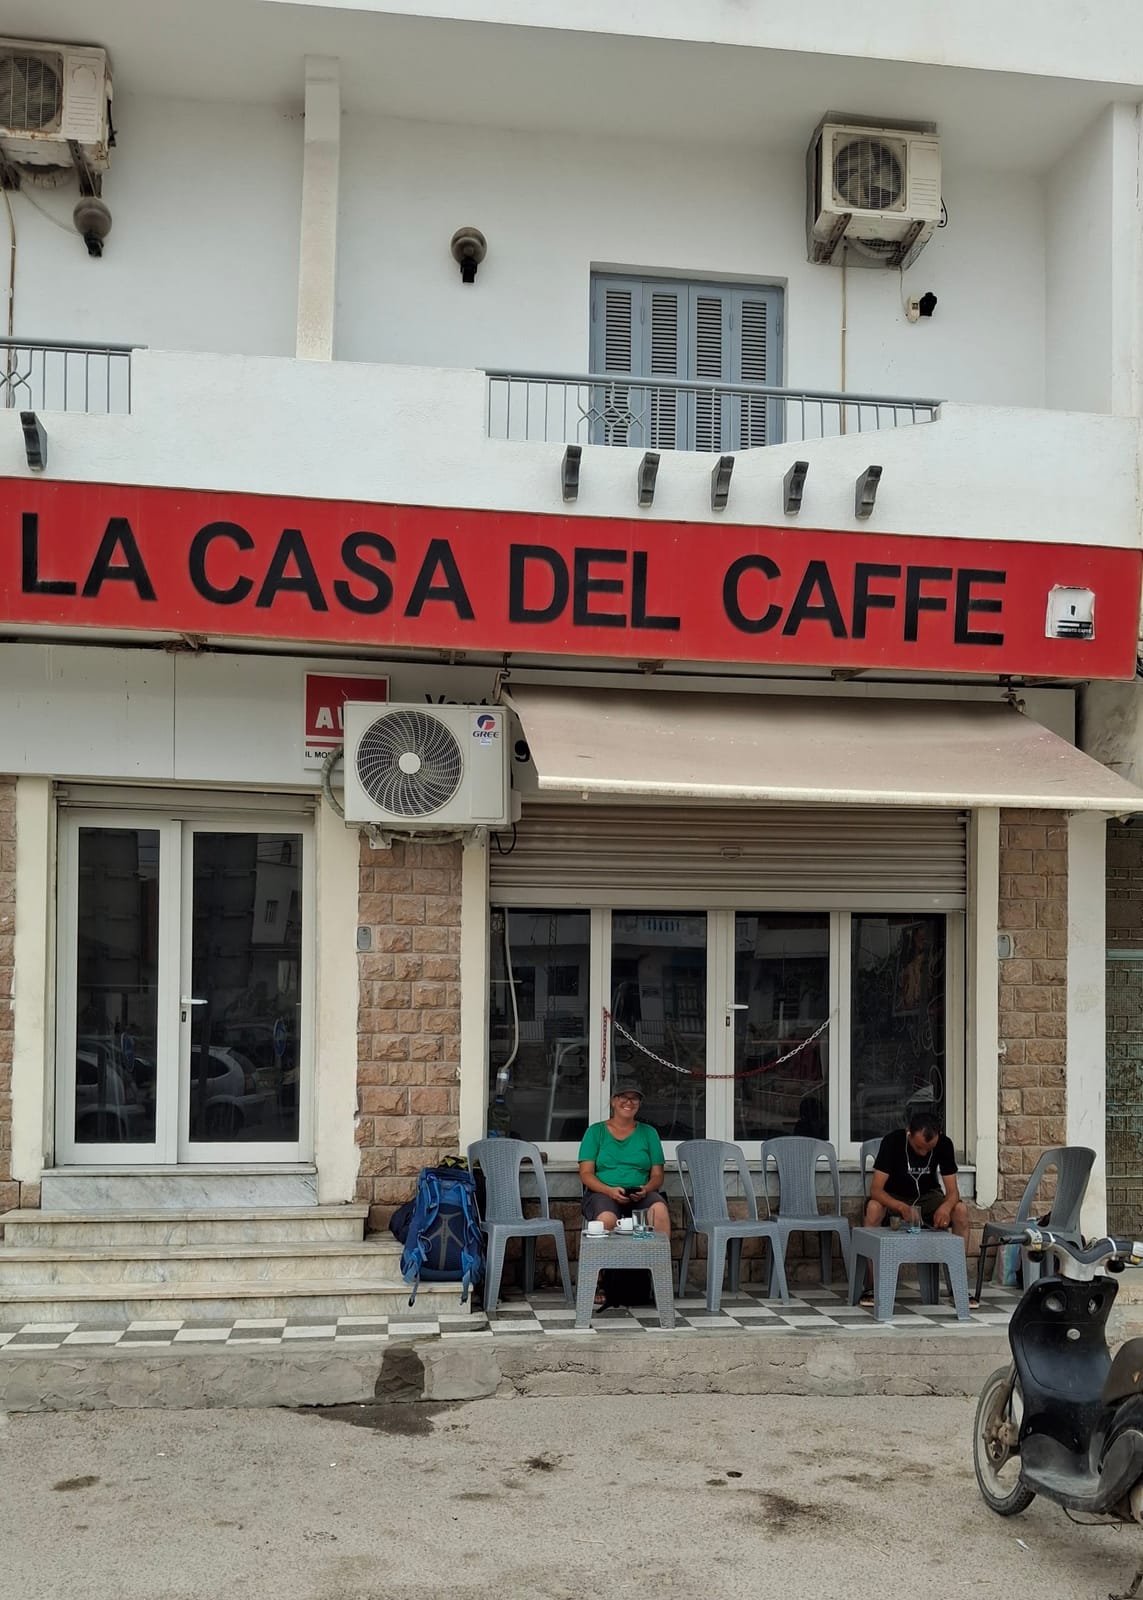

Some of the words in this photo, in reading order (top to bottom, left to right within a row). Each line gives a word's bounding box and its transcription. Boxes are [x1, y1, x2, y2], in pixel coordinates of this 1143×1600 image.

[21, 512, 157, 602] LA
[188, 521, 476, 621] CASA
[508, 544, 681, 632] DEL
[722, 554, 1007, 647] CAFFE
[472, 730, 500, 739] GREE
